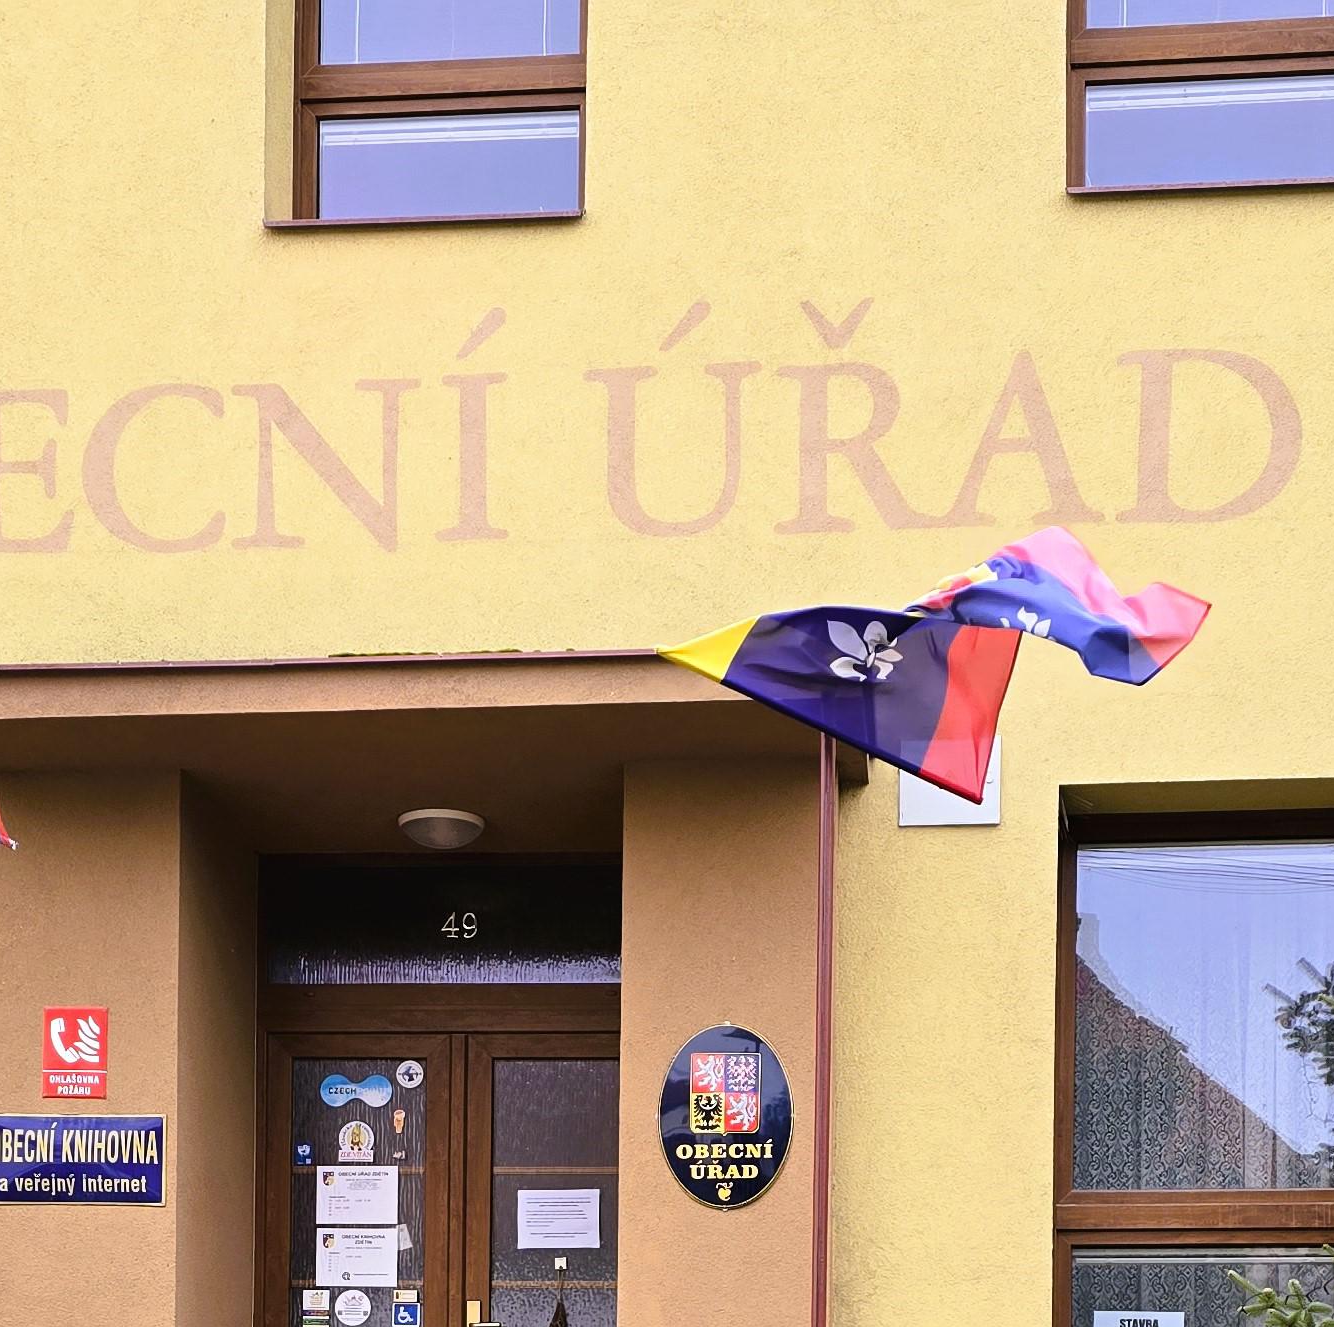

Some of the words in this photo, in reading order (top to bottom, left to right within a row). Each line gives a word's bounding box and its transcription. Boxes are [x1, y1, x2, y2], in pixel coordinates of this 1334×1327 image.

[583, 297, 1303, 538] ÚŘAD
[440, 911, 478, 939] 49
[49, 1074, 100, 1085] OHLAŠOVNA
[57, 1085, 91, 1096] POŽÁRU
[61, 1129, 159, 1165] KNIHOVNA
[675, 1138, 774, 1160] OBECNÍ
[689, 1160, 759, 1180] ÚŘAD
[0, 1177, 9, 1192] a
[14, 1172, 76, 1196] veřejný
[82, 1173, 147, 1193] internet
